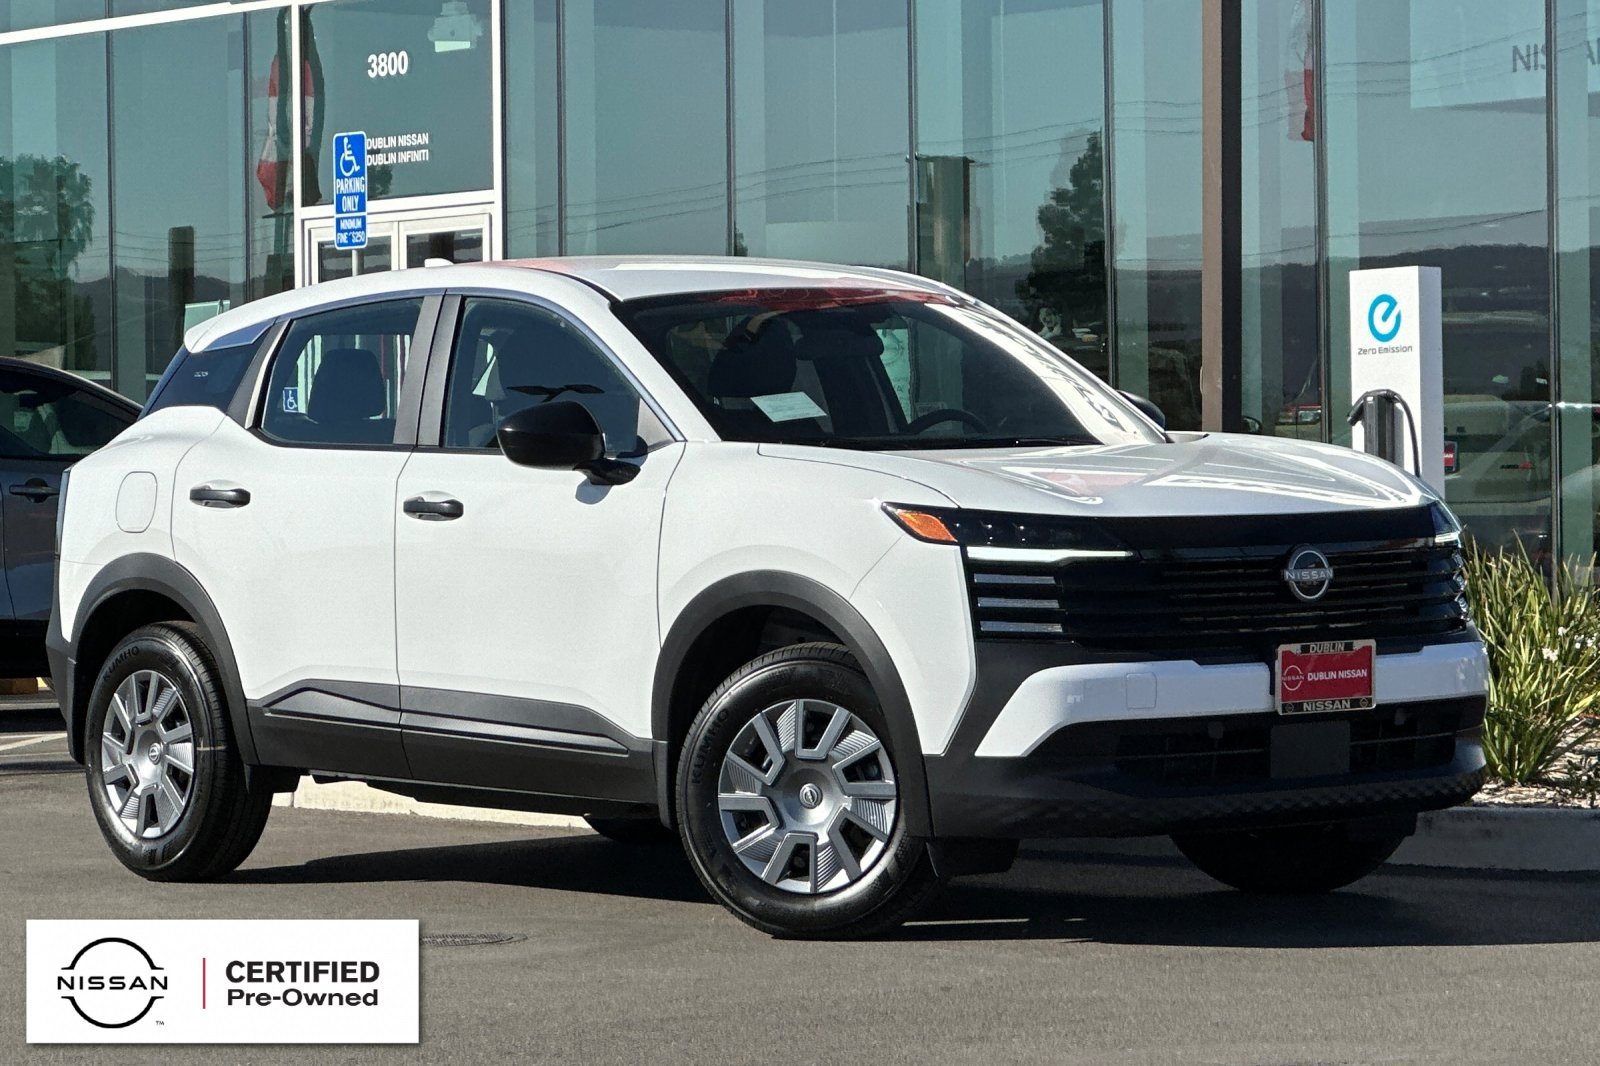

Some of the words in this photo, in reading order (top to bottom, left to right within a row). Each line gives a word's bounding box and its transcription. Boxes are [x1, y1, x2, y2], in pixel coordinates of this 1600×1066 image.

[367, 50, 409, 78] 3800
[366, 138, 396, 150] DUBLIN
[398, 132, 429, 145] NISSAN
[366, 153, 396, 166] DUBLIN
[398, 149, 429, 163] INFINITI
[336, 177, 365, 194] PARKING
[341, 195, 360, 212] ONLY
[340, 218, 362, 230] MINIMUM
[337, 232, 348, 243] FINE
[351, 231, 365, 243] $250
[1378, 345, 1413, 354] Emission
[1285, 569, 1333, 580] NISSAN
[1309, 643, 1345, 653] DUBLIN
[102, 646, 140, 681] KUMHO
[1307, 671, 1337, 681] DUBLIN
[1338, 669, 1367, 679] NISSAN
[1303, 700, 1351, 712] NISSAN
[691, 708, 728, 784] KUMHO
